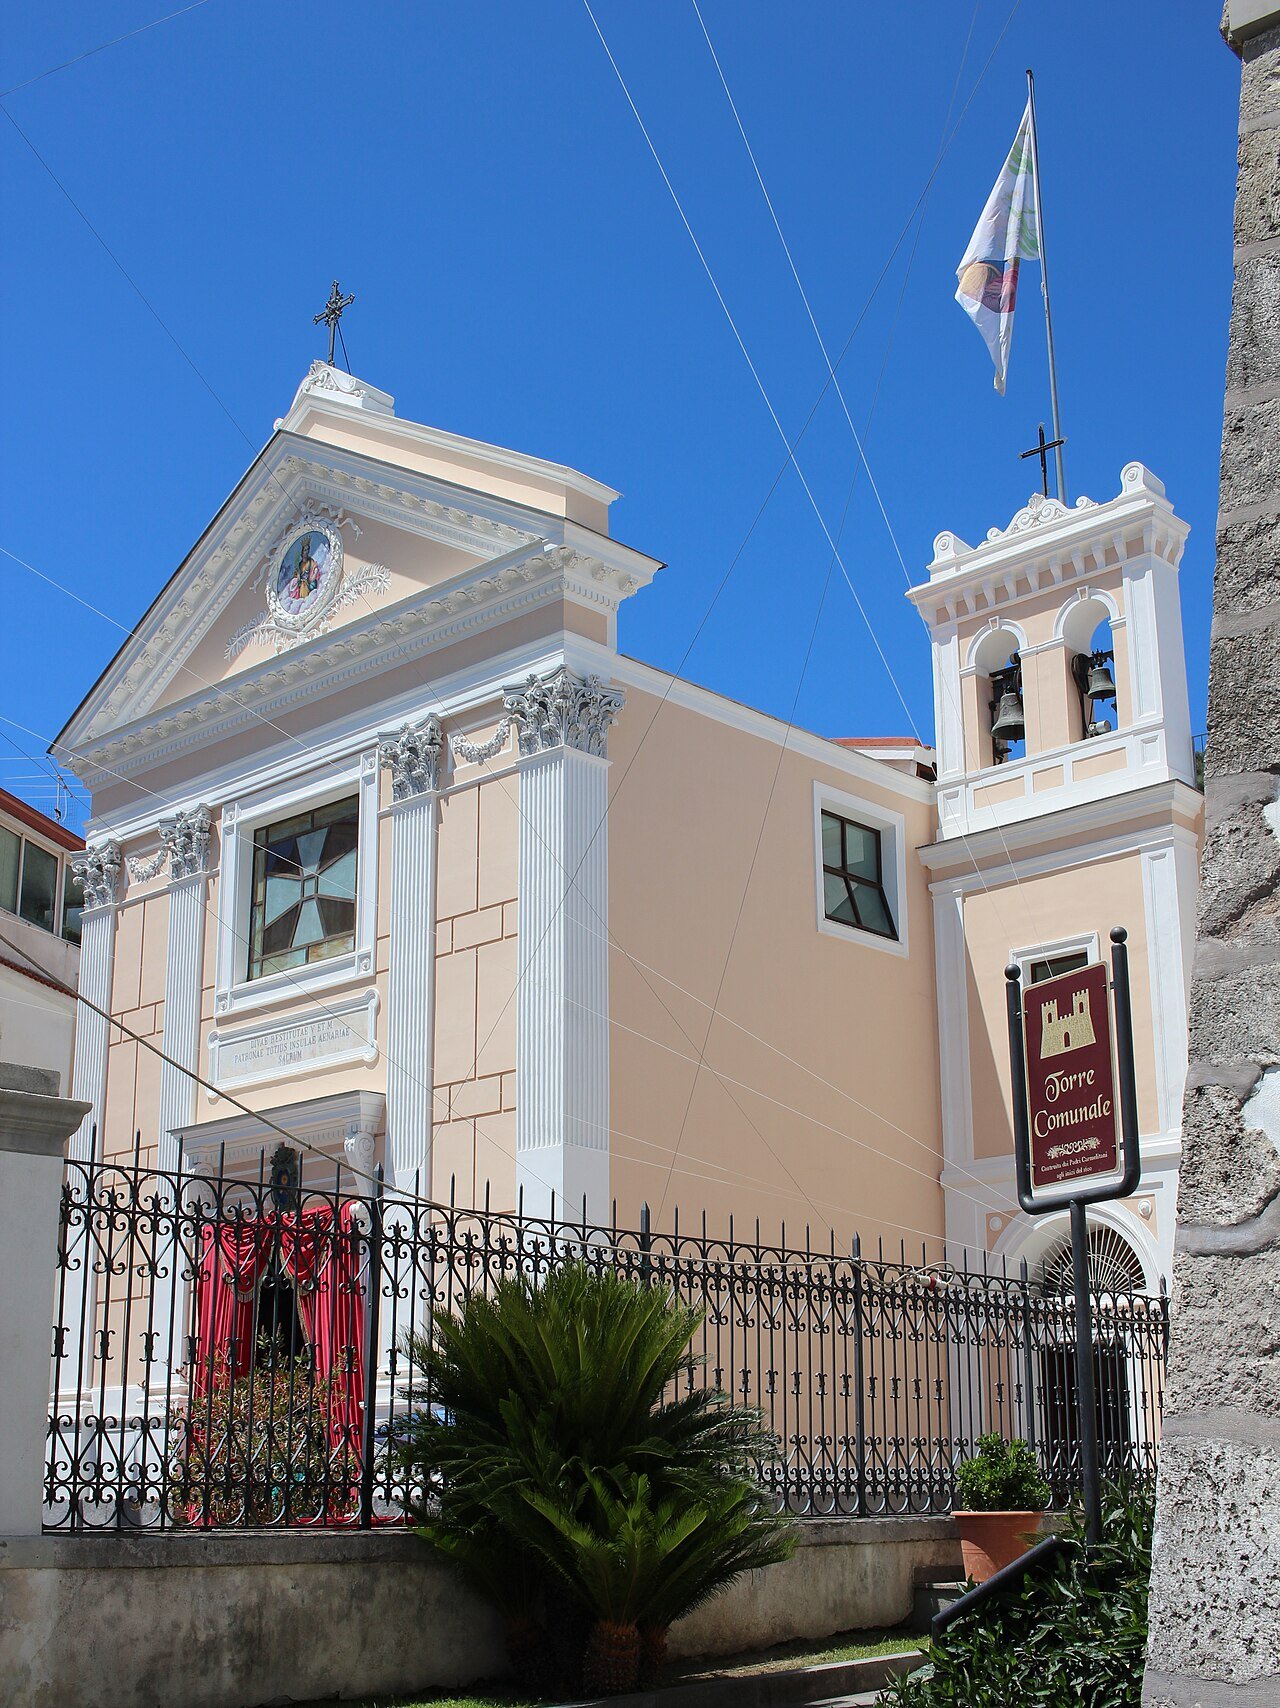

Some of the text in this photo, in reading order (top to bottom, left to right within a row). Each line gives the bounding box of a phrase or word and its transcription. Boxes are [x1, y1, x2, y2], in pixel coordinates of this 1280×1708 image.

[234, 1028, 350, 1064] PATRONAE TOTIUS INSULAE AENARIAE
[250, 1037, 268, 1049] DIVAE
[270, 1027, 308, 1044] RESTITUTAE
[1044, 1069, 1095, 1103] Torre
[1034, 1093, 1111, 1138] Comunale
